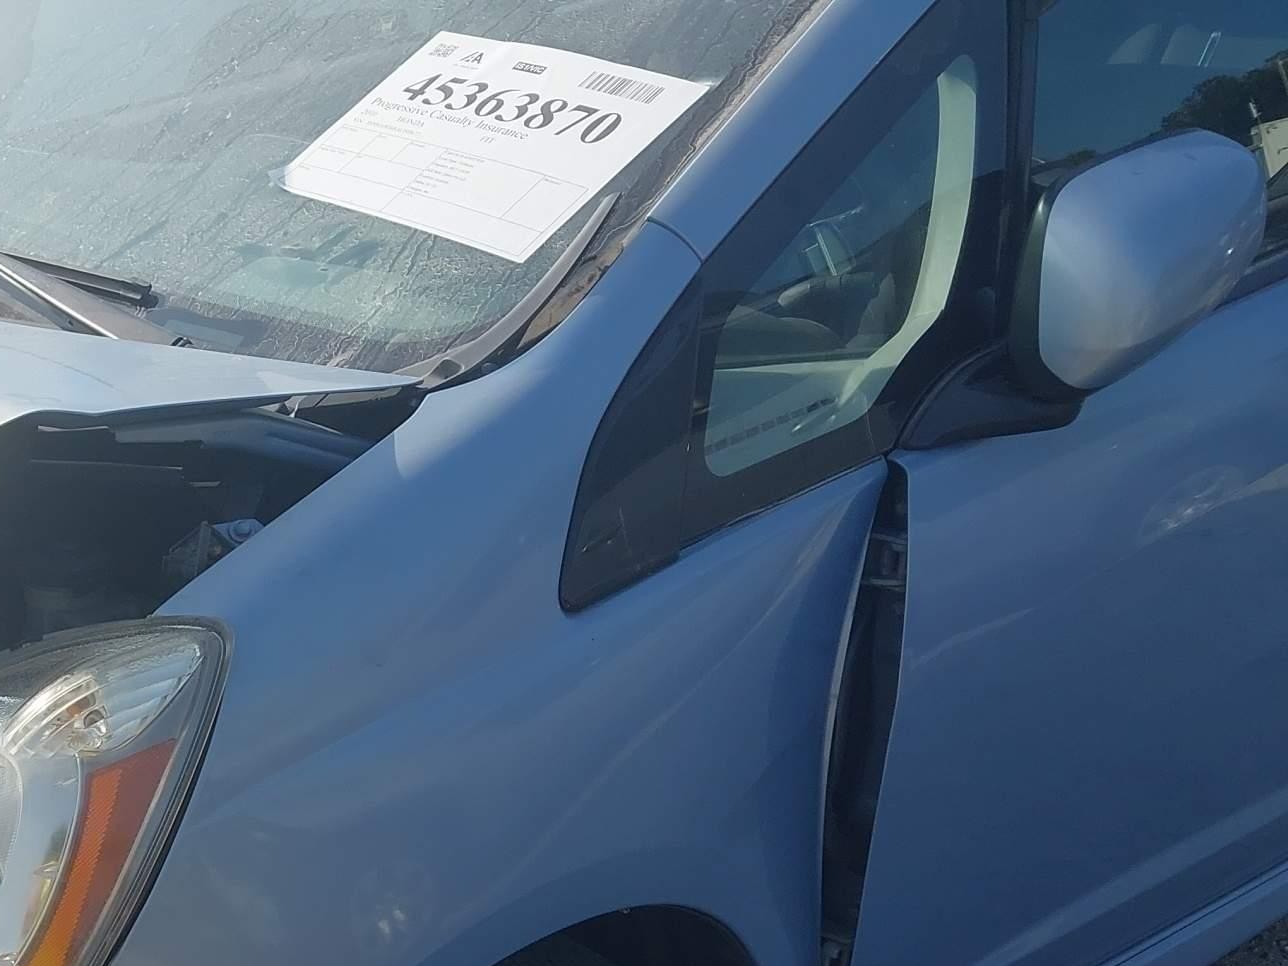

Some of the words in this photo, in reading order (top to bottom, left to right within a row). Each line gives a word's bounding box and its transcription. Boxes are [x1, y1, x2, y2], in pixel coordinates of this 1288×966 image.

[370, 96, 429, 116] Progressive
[430, 110, 474, 128] Casualty
[475, 120, 529, 140] Insurance
[404, 74, 622, 144] 45363870
